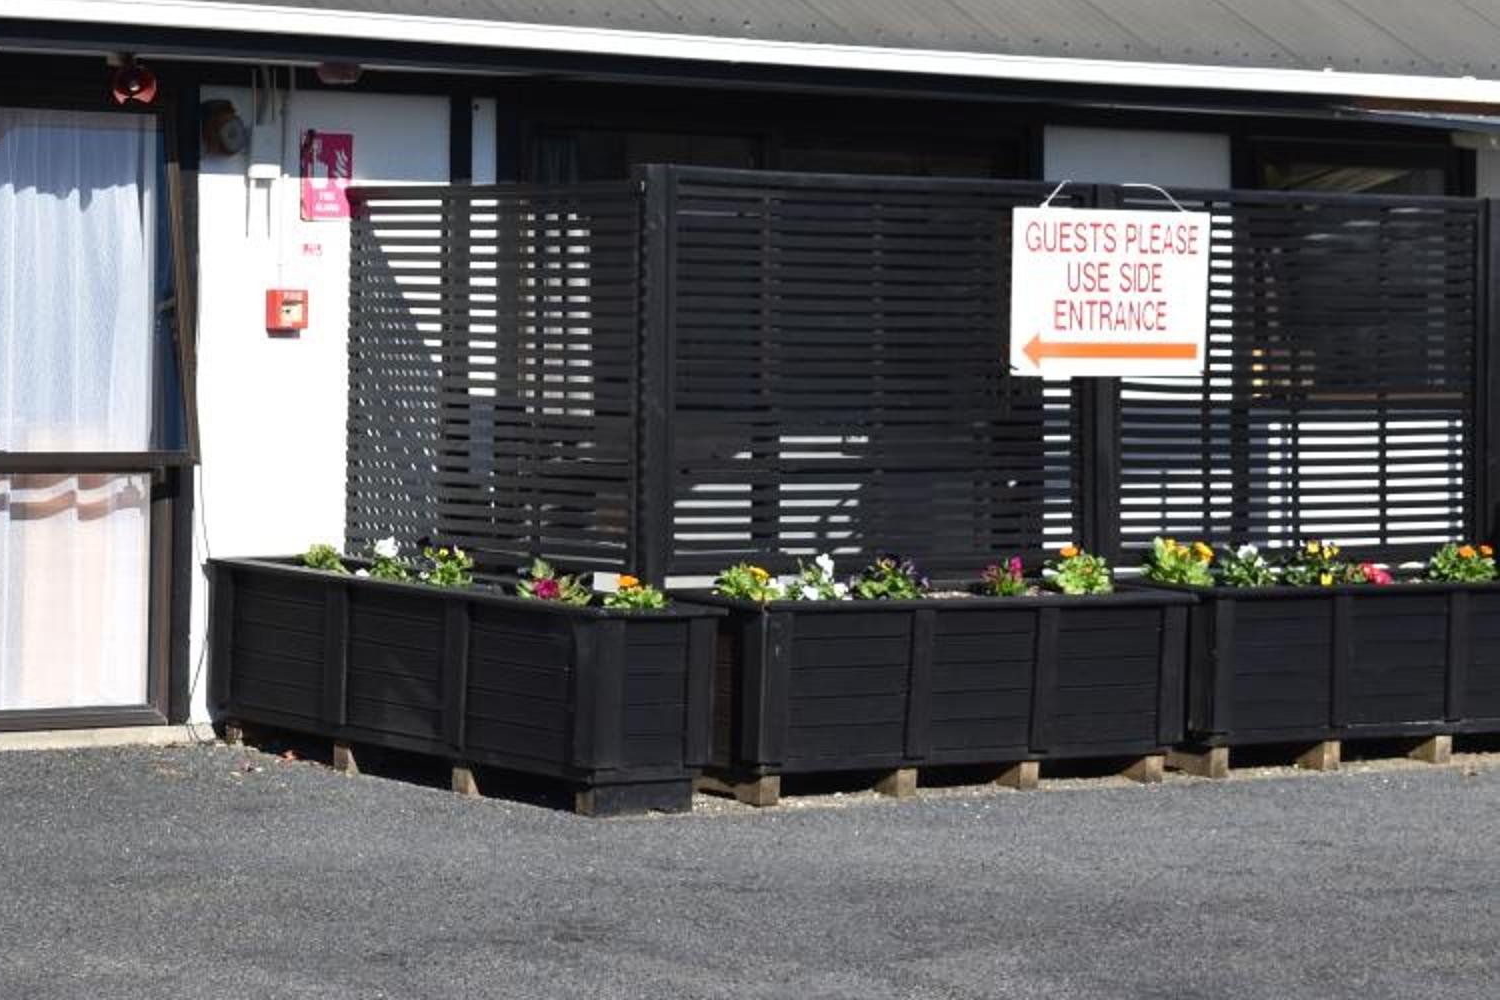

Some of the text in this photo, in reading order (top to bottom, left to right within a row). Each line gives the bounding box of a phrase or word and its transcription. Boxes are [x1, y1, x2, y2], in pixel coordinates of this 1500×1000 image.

[1025, 221, 1198, 255] GUESTS PLEASE
[1067, 262, 1163, 293] USE SIDE
[1054, 300, 1167, 331] ENTRANCE
